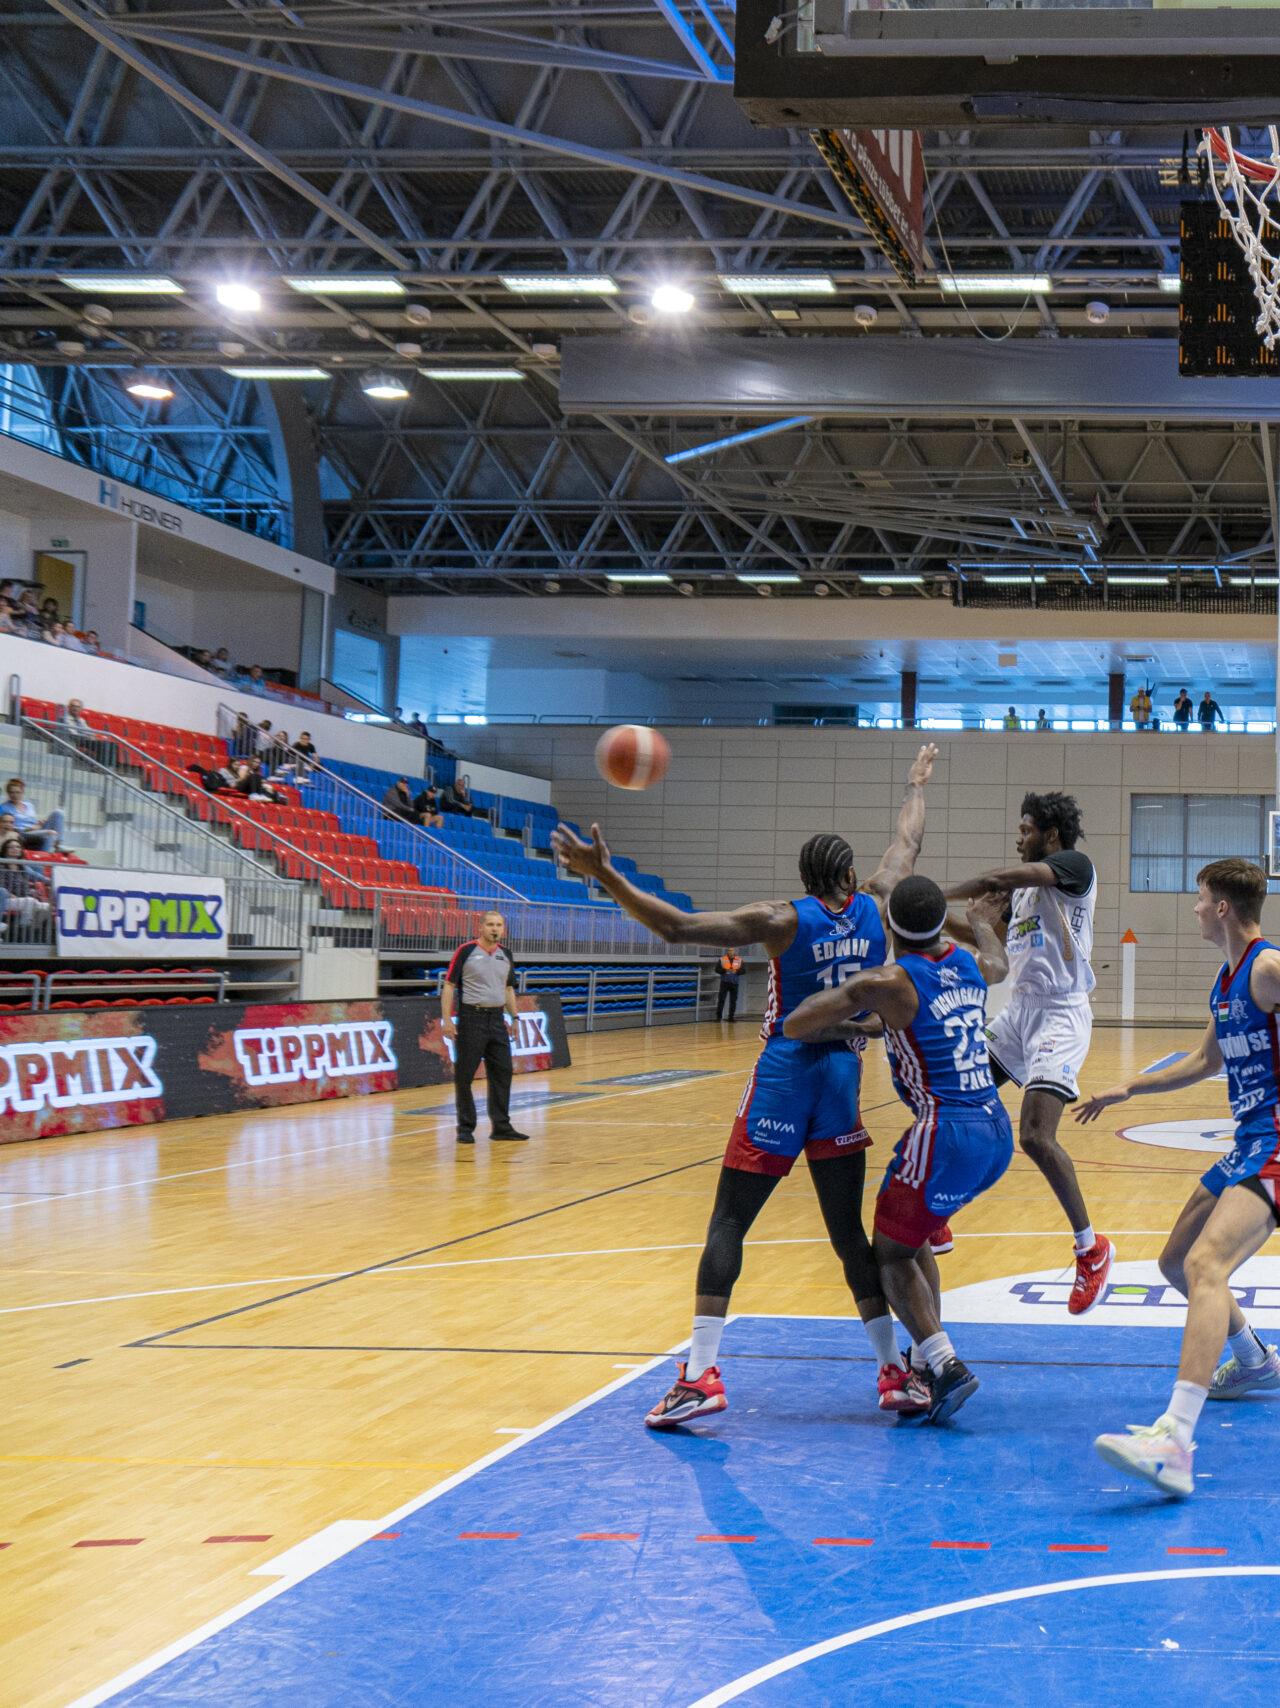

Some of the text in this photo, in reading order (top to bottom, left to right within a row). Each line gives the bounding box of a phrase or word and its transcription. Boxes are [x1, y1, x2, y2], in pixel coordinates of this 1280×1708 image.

[812, 938, 870, 962] EDWIN
[944, 1008, 990, 1072] 23
[1248, 1029, 1271, 1052] SE
[757, 1117, 795, 1134] MVM
